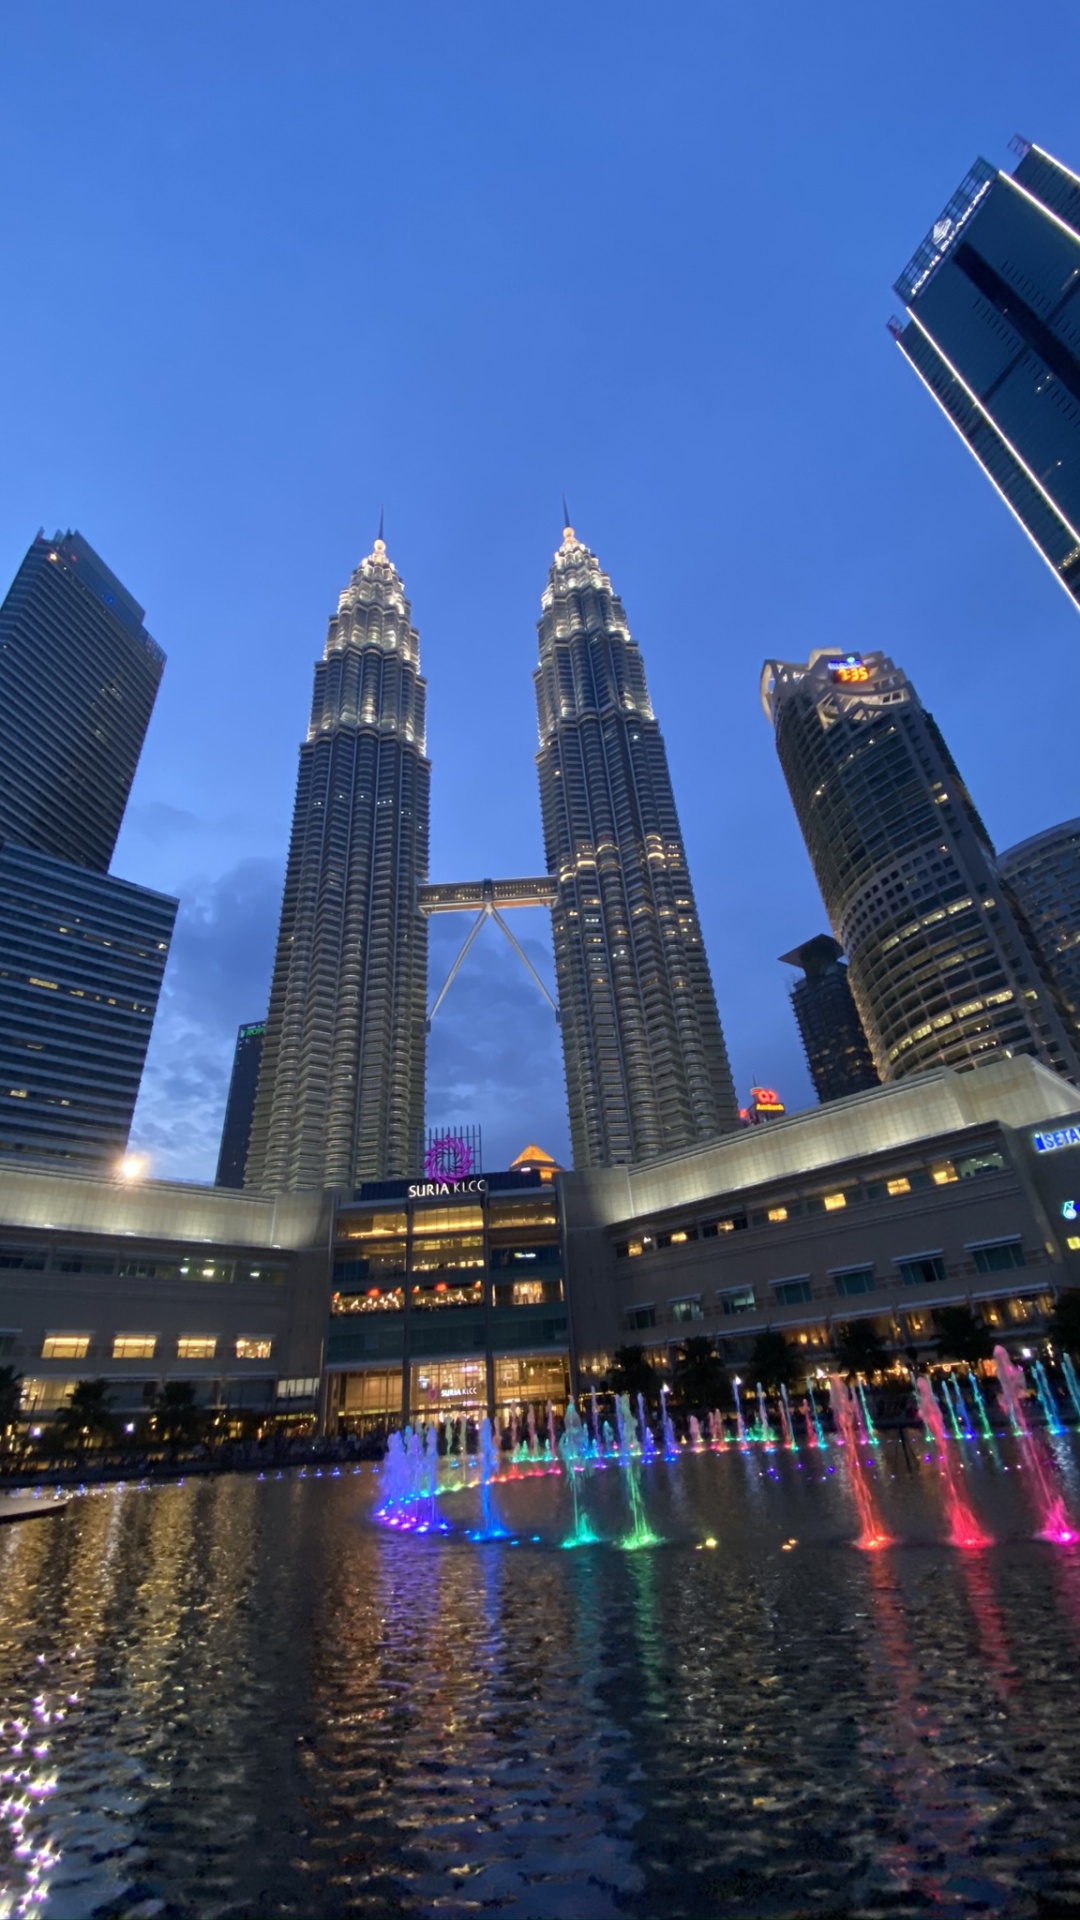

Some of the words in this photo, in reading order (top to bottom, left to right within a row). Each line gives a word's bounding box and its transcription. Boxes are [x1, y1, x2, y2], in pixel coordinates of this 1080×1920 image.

[408, 1182, 450, 1198] SURIA
[453, 1179, 486, 1193] KLCC
[441, 1389, 462, 1397] SURIA
[462, 1387, 477, 1395] KLCC
